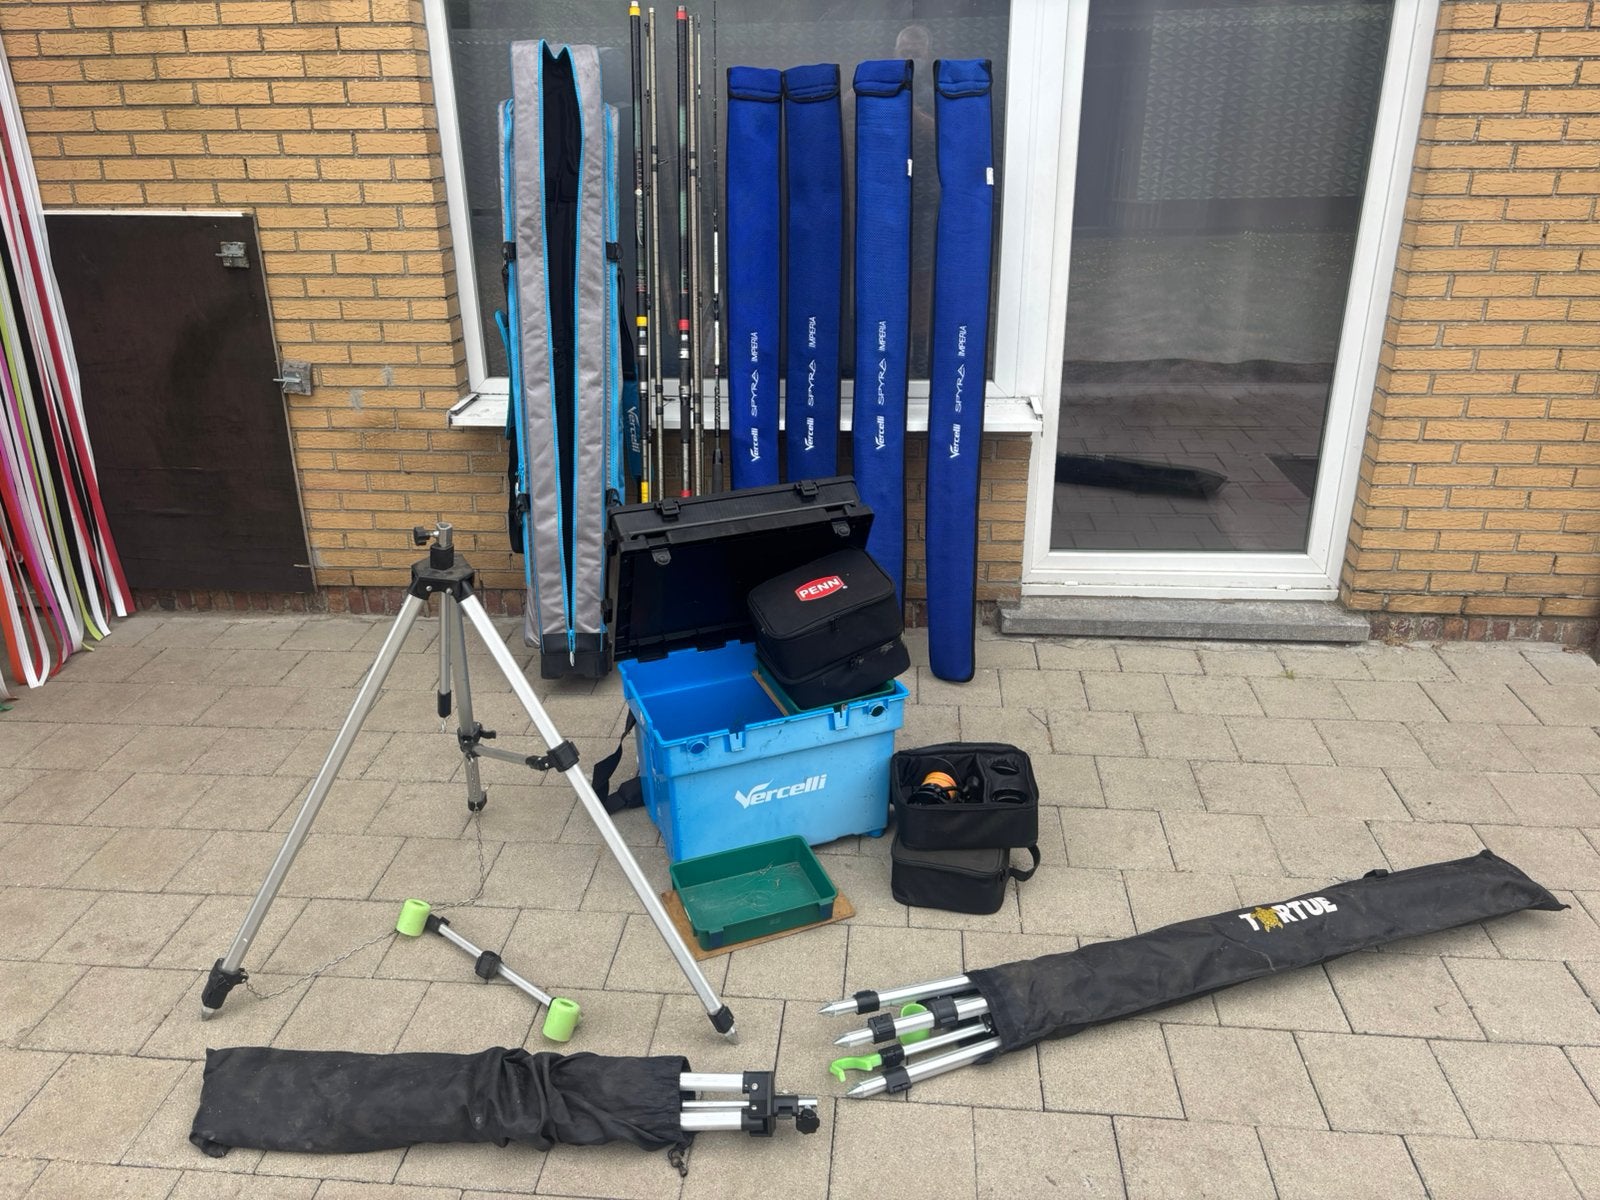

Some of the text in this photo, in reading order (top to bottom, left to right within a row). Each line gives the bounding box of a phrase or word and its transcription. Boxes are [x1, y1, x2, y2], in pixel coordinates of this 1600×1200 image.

[750, 369, 759, 417] SPYRA
[805, 316, 817, 451] Vercelli SPYRA IMPERIA
[875, 320, 887, 450] Vercelli SPYRA IMPERIA
[950, 325, 967, 459] Vercelli SPYRA IMPERIA
[627, 406, 641, 453] Vercelli
[750, 427, 761, 462] Vercelli
[799, 577, 840, 599] PENN
[734, 773, 827, 809] Vercelli
[1238, 896, 1338, 932] TRTUE
